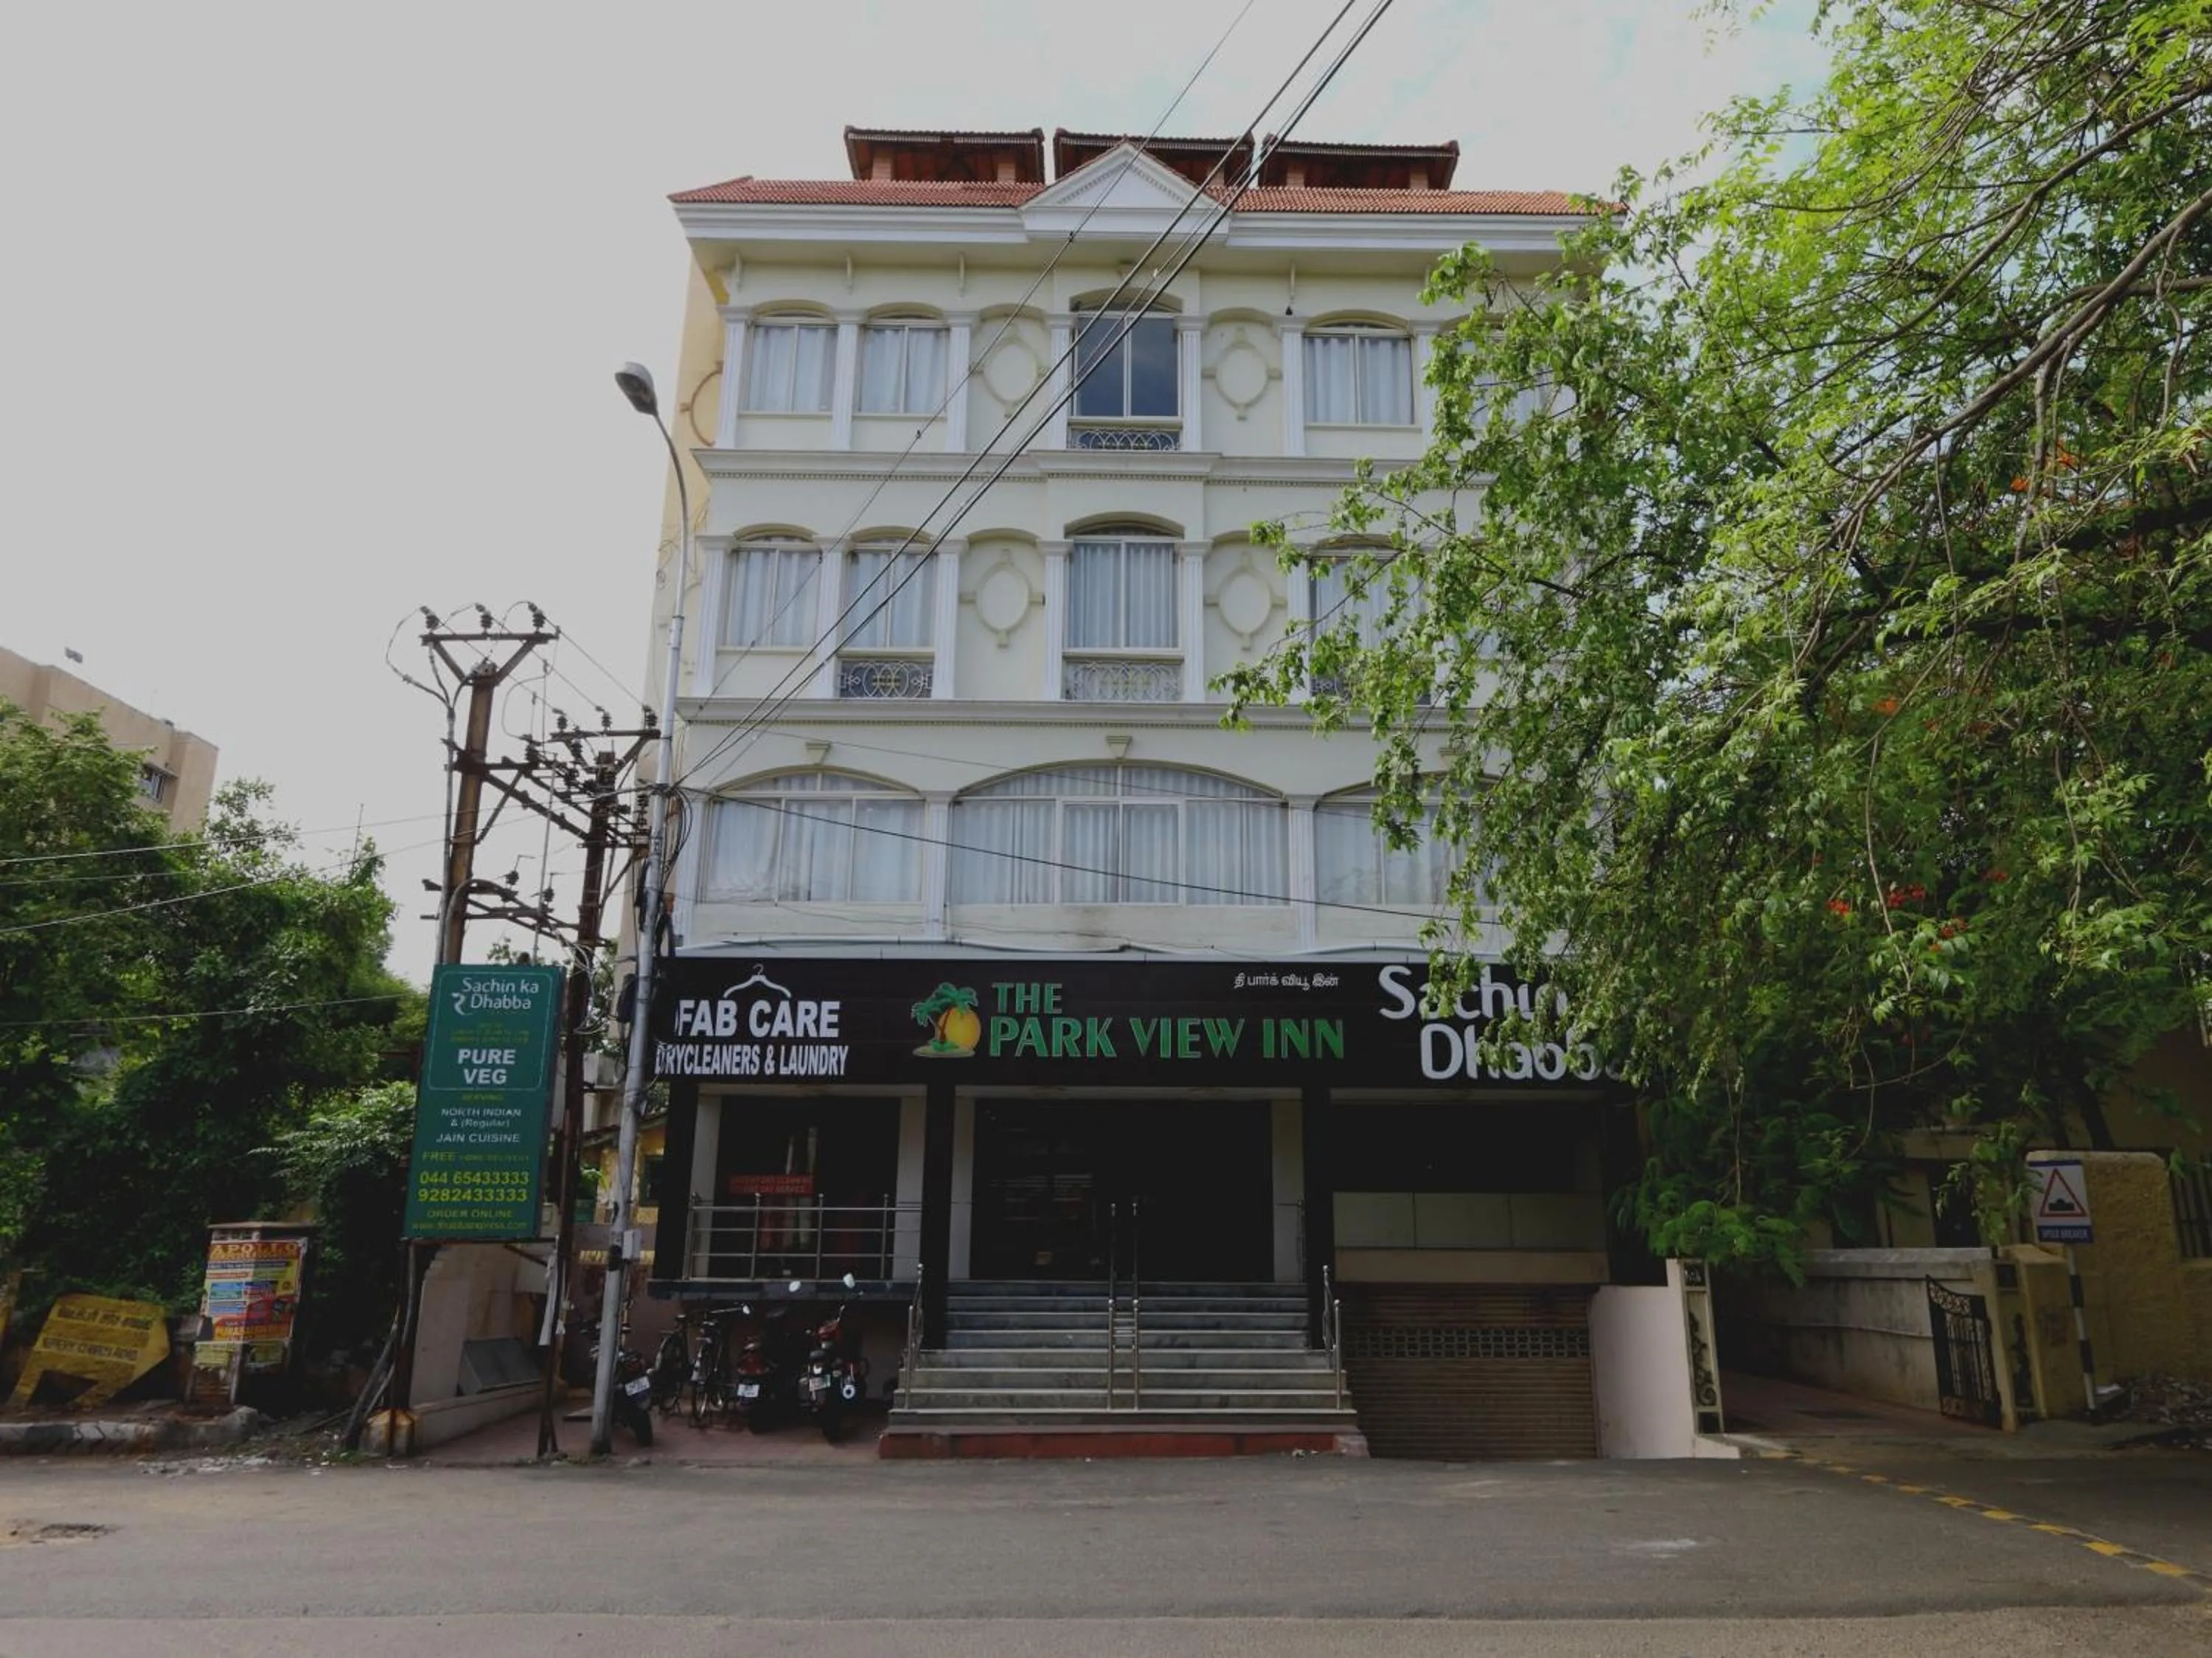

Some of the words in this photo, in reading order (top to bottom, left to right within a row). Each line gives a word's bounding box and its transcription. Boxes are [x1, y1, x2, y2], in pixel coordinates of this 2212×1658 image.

[462, 977, 515, 993] Sachin
[520, 979, 540, 993] ka
[470, 993, 532, 1010] Dhabba
[992, 982, 1062, 1014] THE
[675, 999, 737, 1038] FAB
[749, 999, 841, 1038] CARE
[989, 1016, 1117, 1058] PARK
[1130, 1017, 1245, 1058] VIEW
[1262, 1018, 1344, 1058] INN
[458, 1048, 516, 1064] PURE
[655, 1044, 760, 1075] DRYCLEANERS
[764, 1045, 776, 1075] &
[779, 1045, 849, 1075] LAUNDRY
[463, 1068, 507, 1084] VEG
[441, 1109, 480, 1117] NORTH
[483, 1109, 521, 1117] INDIAN
[436, 1133, 465, 1142] JAIN
[468, 1134, 520, 1142] CUISINE
[422, 1151, 455, 1162] FREE
[420, 1171, 448, 1184] 044
[427, 1209, 468, 1218] ORDER
[470, 1209, 514, 1218] ONLINE
